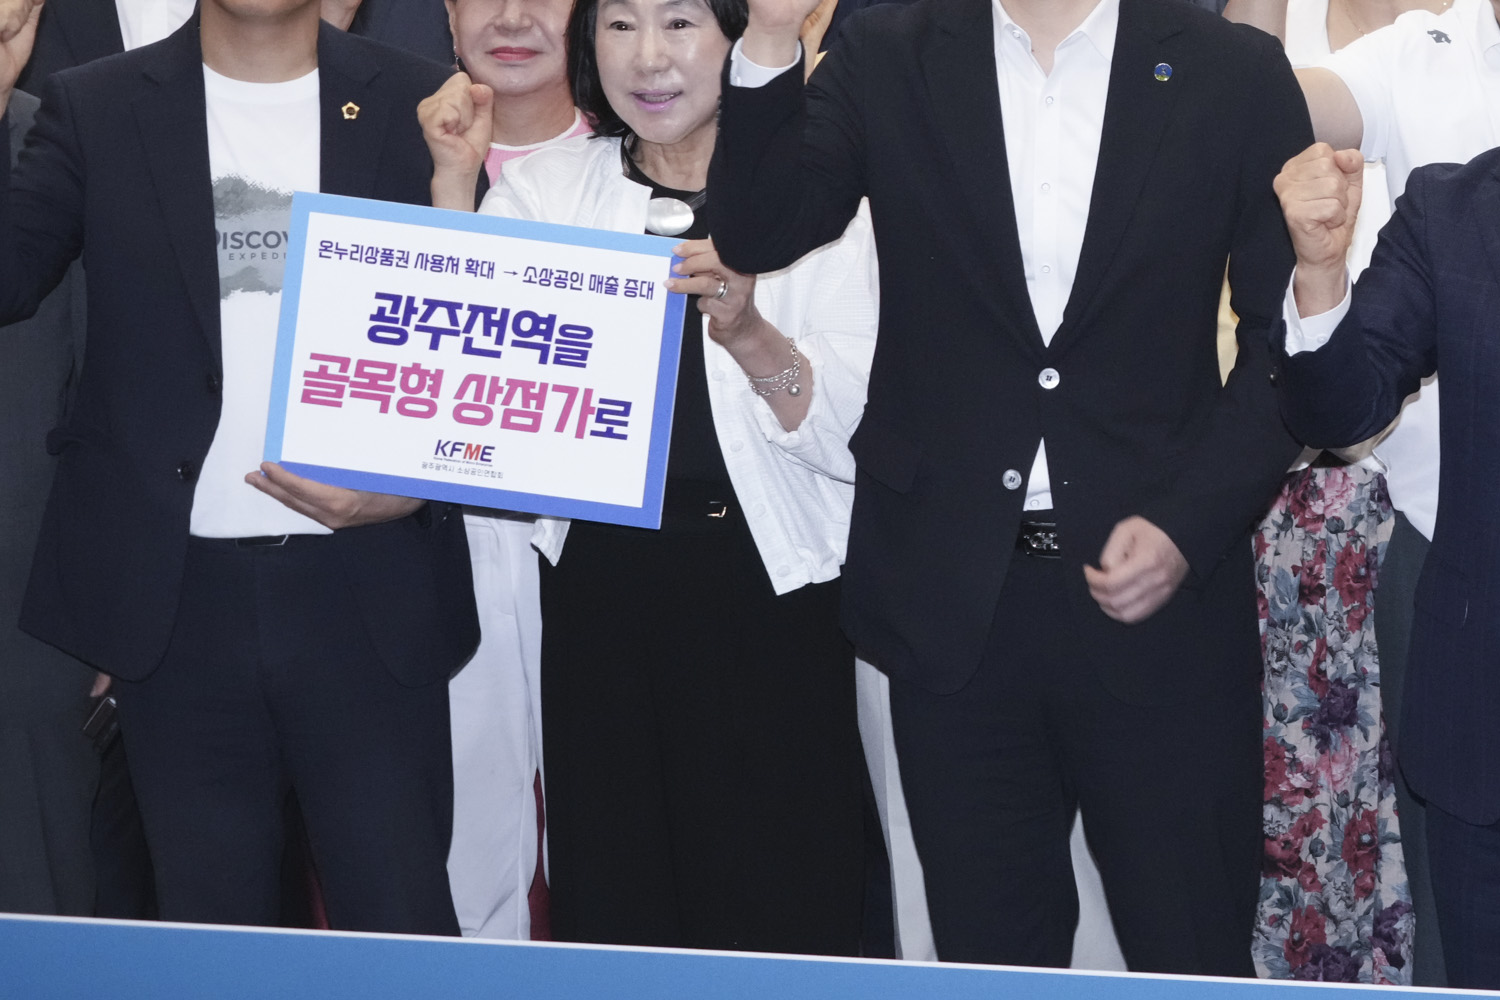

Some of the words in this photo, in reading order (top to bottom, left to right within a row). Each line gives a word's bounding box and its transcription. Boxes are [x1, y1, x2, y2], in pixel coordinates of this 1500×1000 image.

[215, 230, 289, 250] ISCO
[319, 240, 409, 268] 온누리상품권
[414, 253, 459, 275] 사용처
[465, 258, 495, 279] 확대
[523, 266, 583, 291] 소상공인
[589, 274, 619, 295] 매출
[624, 279, 654, 300] 증대
[366, 291, 595, 368] 광주전역을
[300, 352, 444, 420] 골목형
[453, 374, 632, 440] 상점가로
[434, 439, 496, 463] KFME
